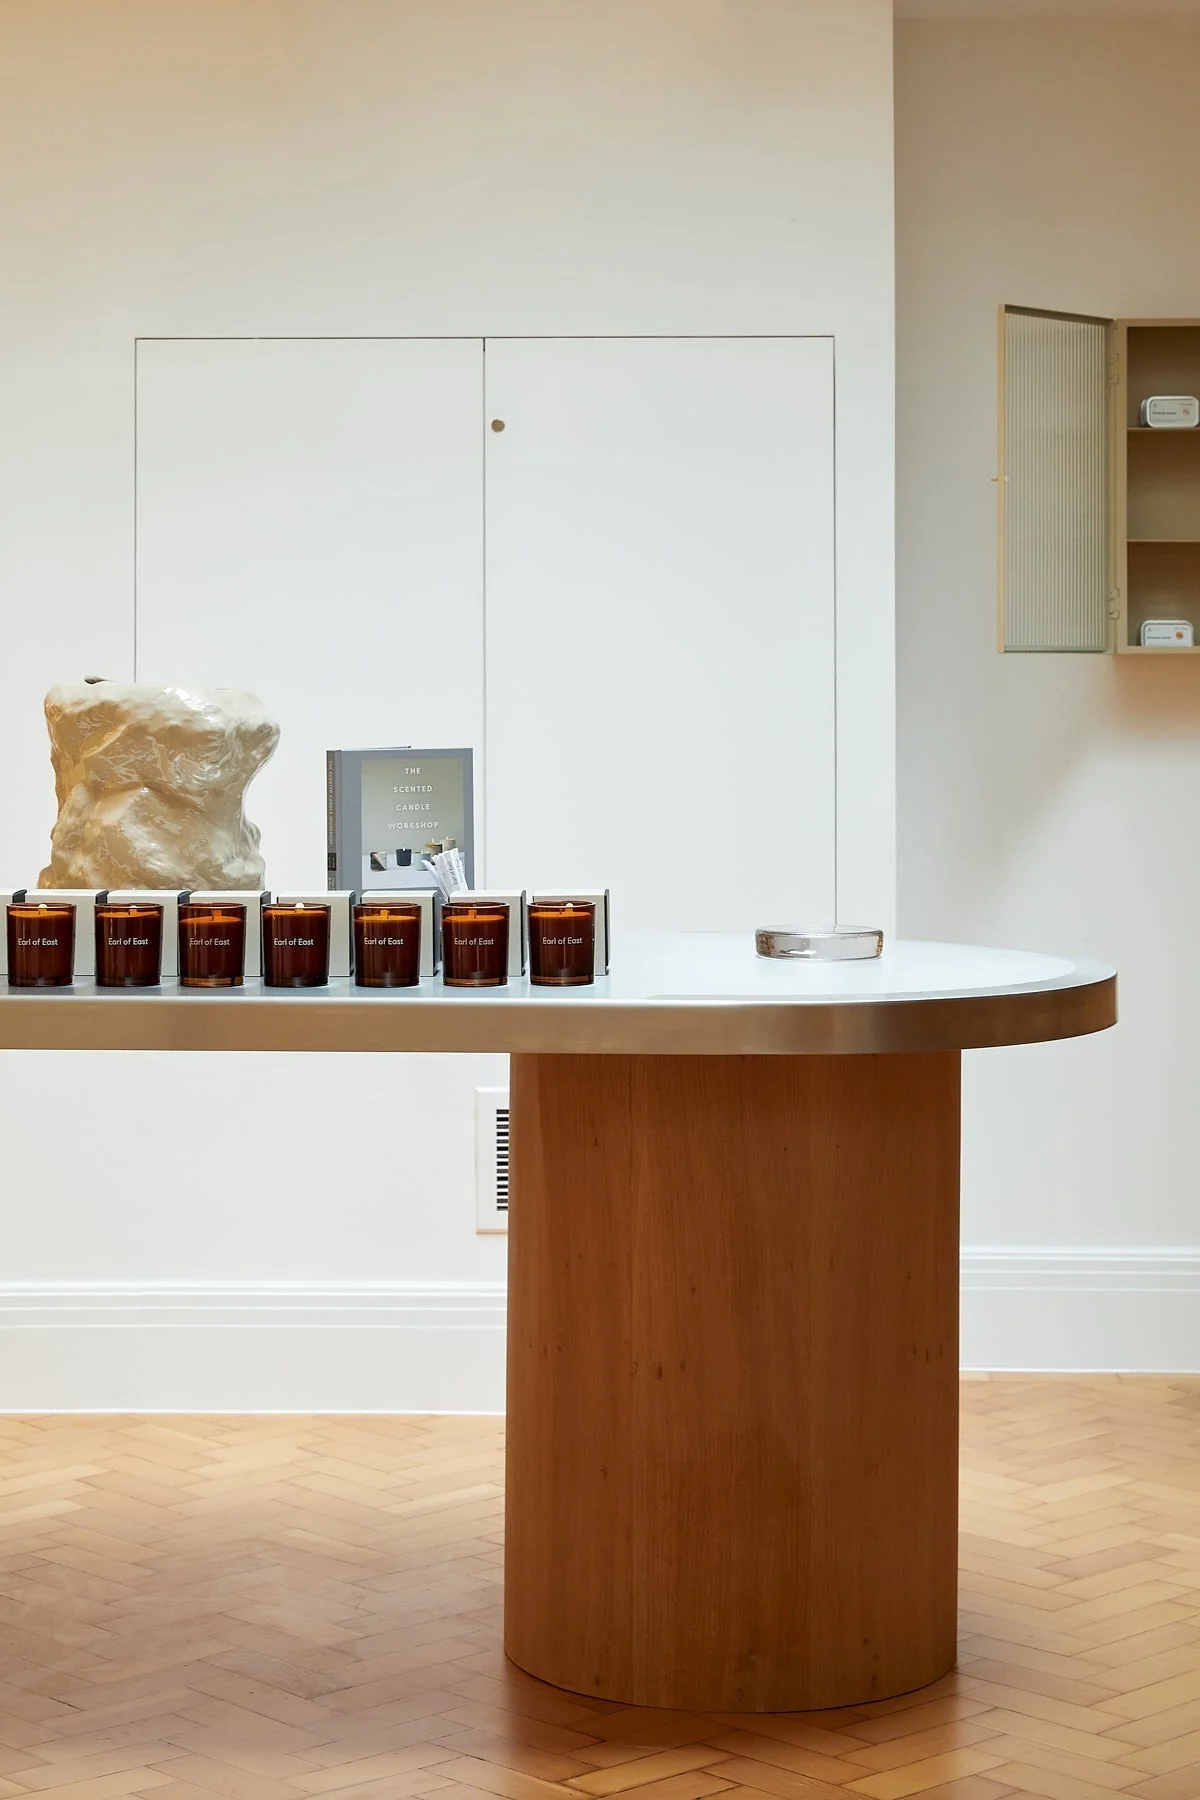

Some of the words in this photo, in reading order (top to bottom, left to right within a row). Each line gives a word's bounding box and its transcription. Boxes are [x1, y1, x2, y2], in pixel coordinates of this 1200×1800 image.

[405, 767, 421, 775] THE
[18, 938, 31, 946] Earl
[32, 938, 40, 946] of
[42, 938, 58, 946] East
[108, 938, 121, 946] Earl
[123, 938, 131, 946] of
[133, 938, 148, 946] East
[190, 938, 203, 946] Earl
[204, 938, 212, 946] of
[214, 938, 230, 946] East
[274, 938, 287, 946] Earl
[288, 938, 296, 946] of
[298, 938, 314, 946] East
[454, 938, 467, 946] Earl
[468, 938, 477, 946] of
[478, 938, 494, 946] East
